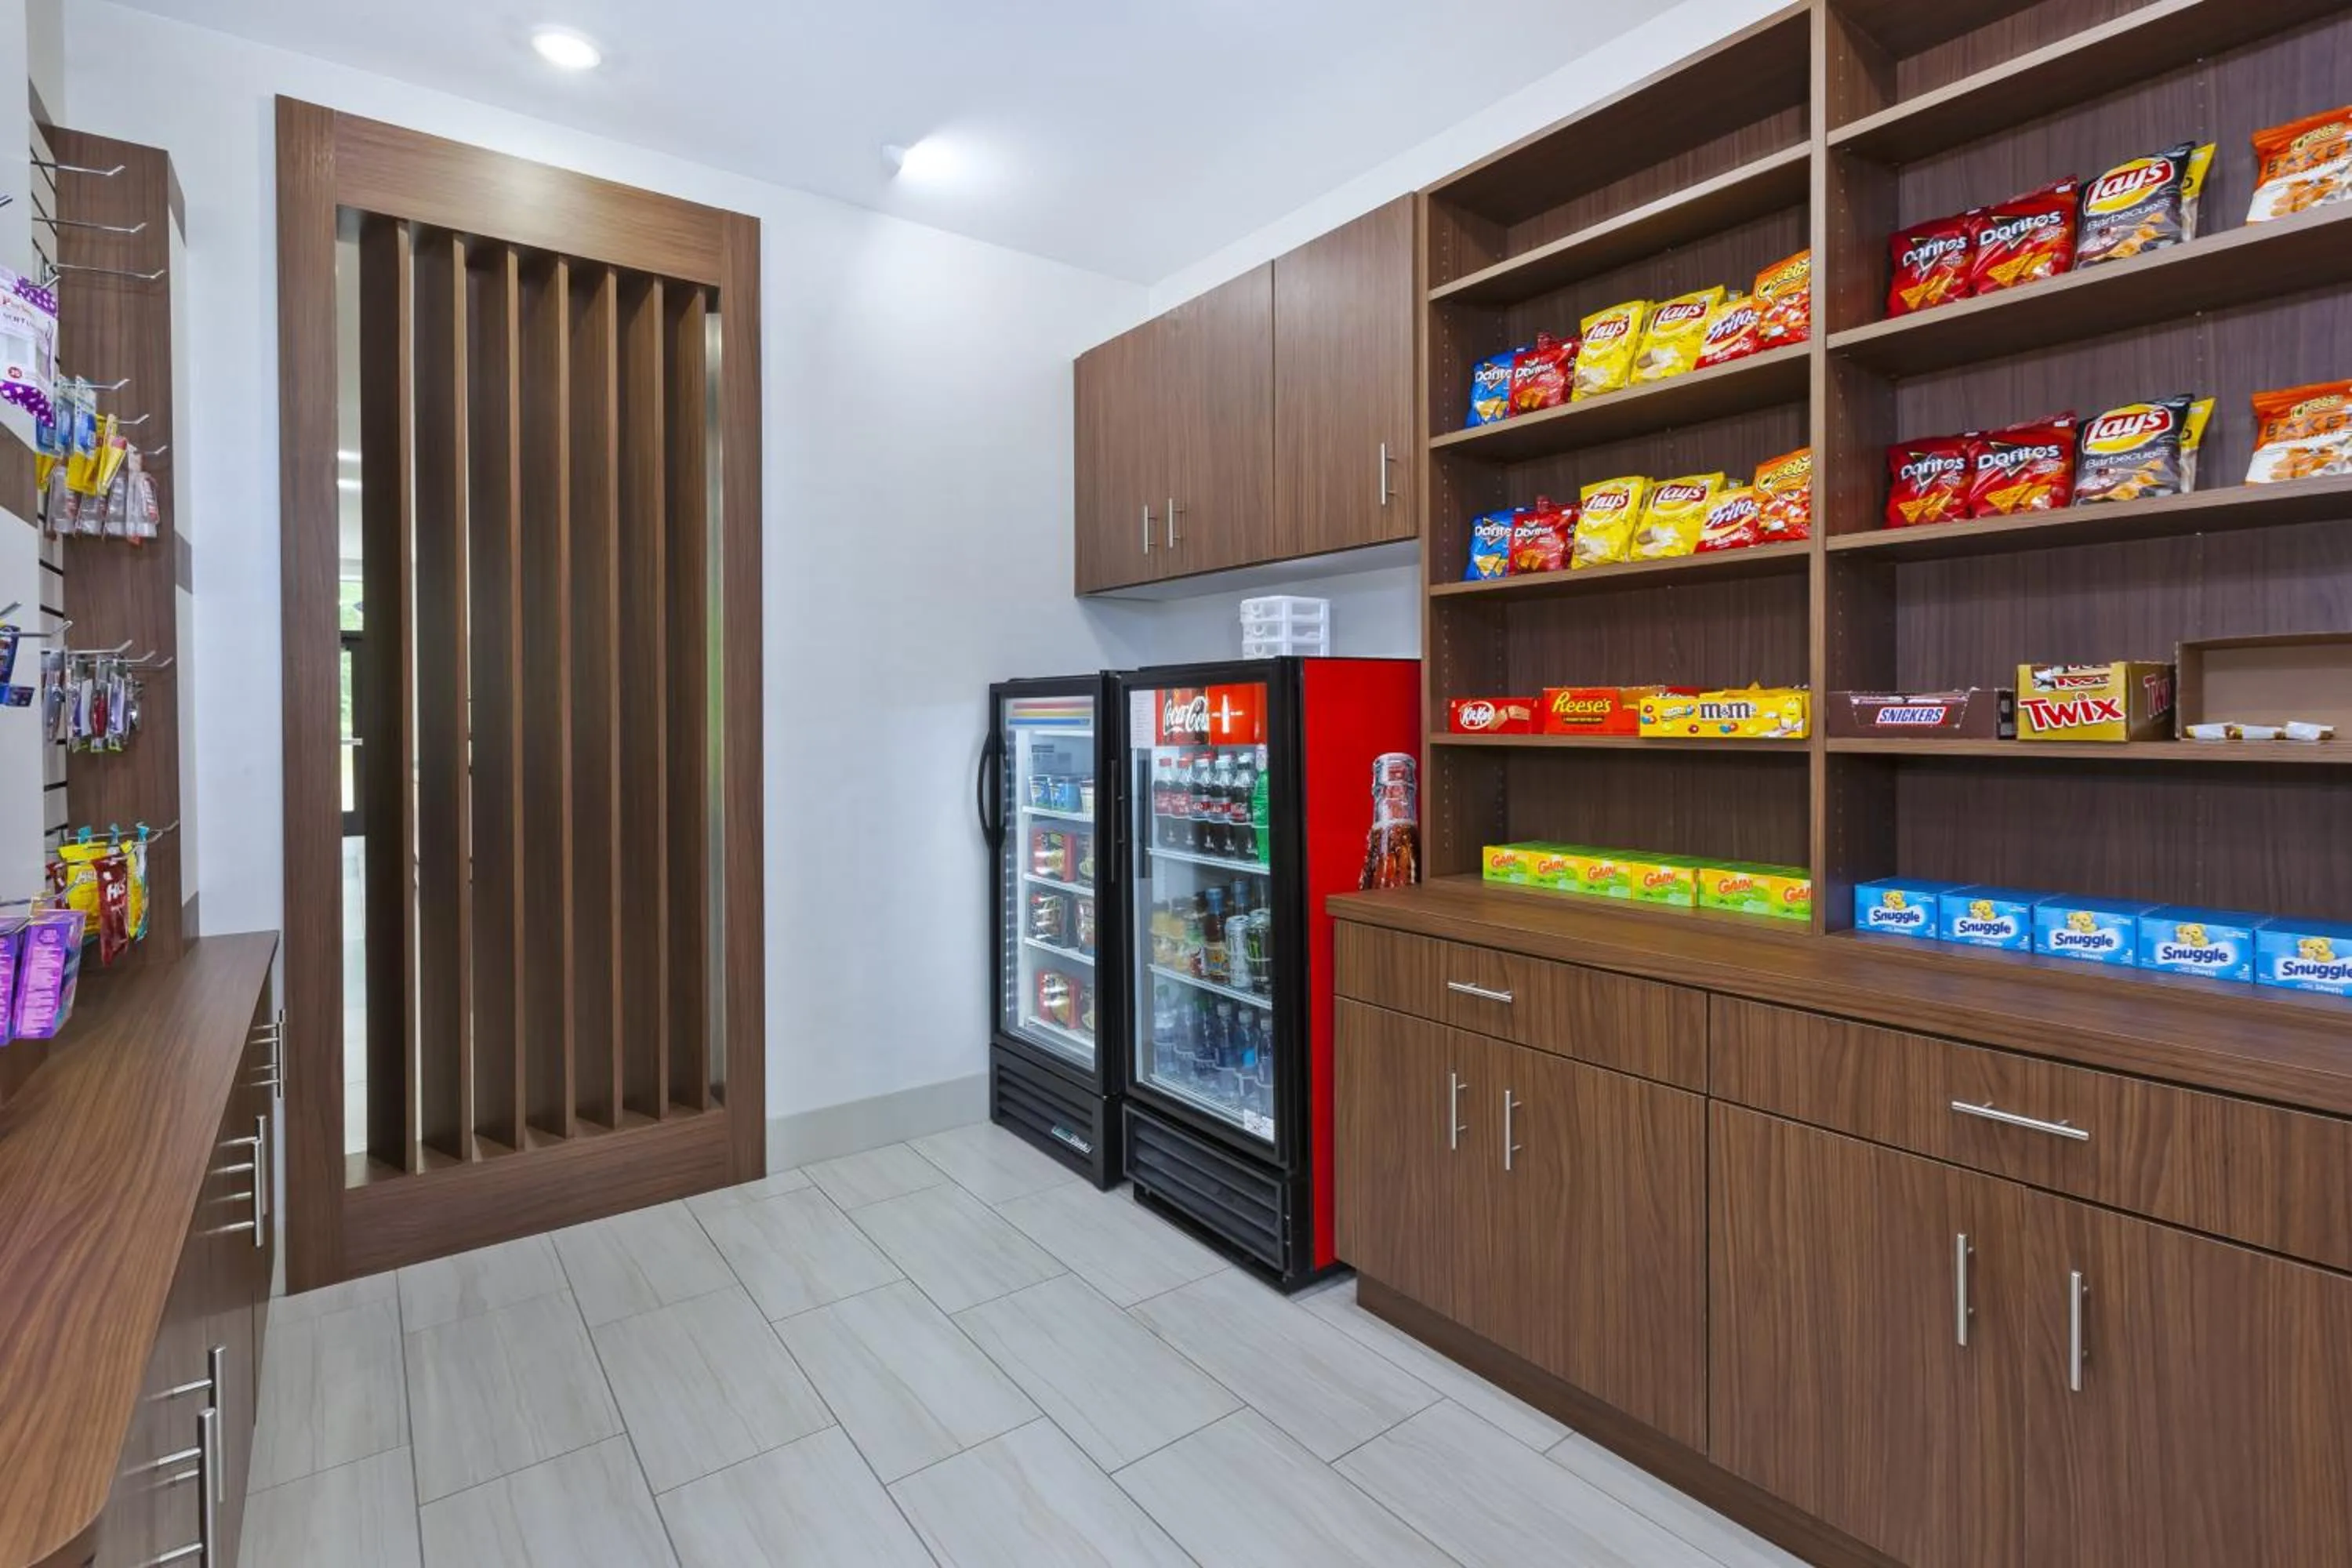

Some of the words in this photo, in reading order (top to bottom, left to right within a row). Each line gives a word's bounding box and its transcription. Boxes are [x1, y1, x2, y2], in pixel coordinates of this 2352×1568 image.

[2267, 140, 2352, 175] BAKE
[1980, 211, 2061, 246] Doritos
[1903, 236, 1967, 267] Doritos
[1475, 368, 1512, 383] Dorito
[1515, 361, 1554, 380] Doritos
[2267, 416, 2352, 438] BAKE
[1978, 444, 2060, 470] Doritos
[1901, 457, 1965, 480] Doritos
[1475, 525, 1512, 539] Dorito
[1515, 526, 1553, 537] Doritos
[1552, 691, 1612, 713] Reese's
[2020, 691, 2125, 731] Twix
[1879, 708, 1944, 722] SNICKERS
[1872, 909, 1920, 924] Snuggle
[1958, 920, 2011, 935] Snuggle
[2054, 931, 2114, 948] Snuggle
[2161, 946, 2228, 964] Snuggle
